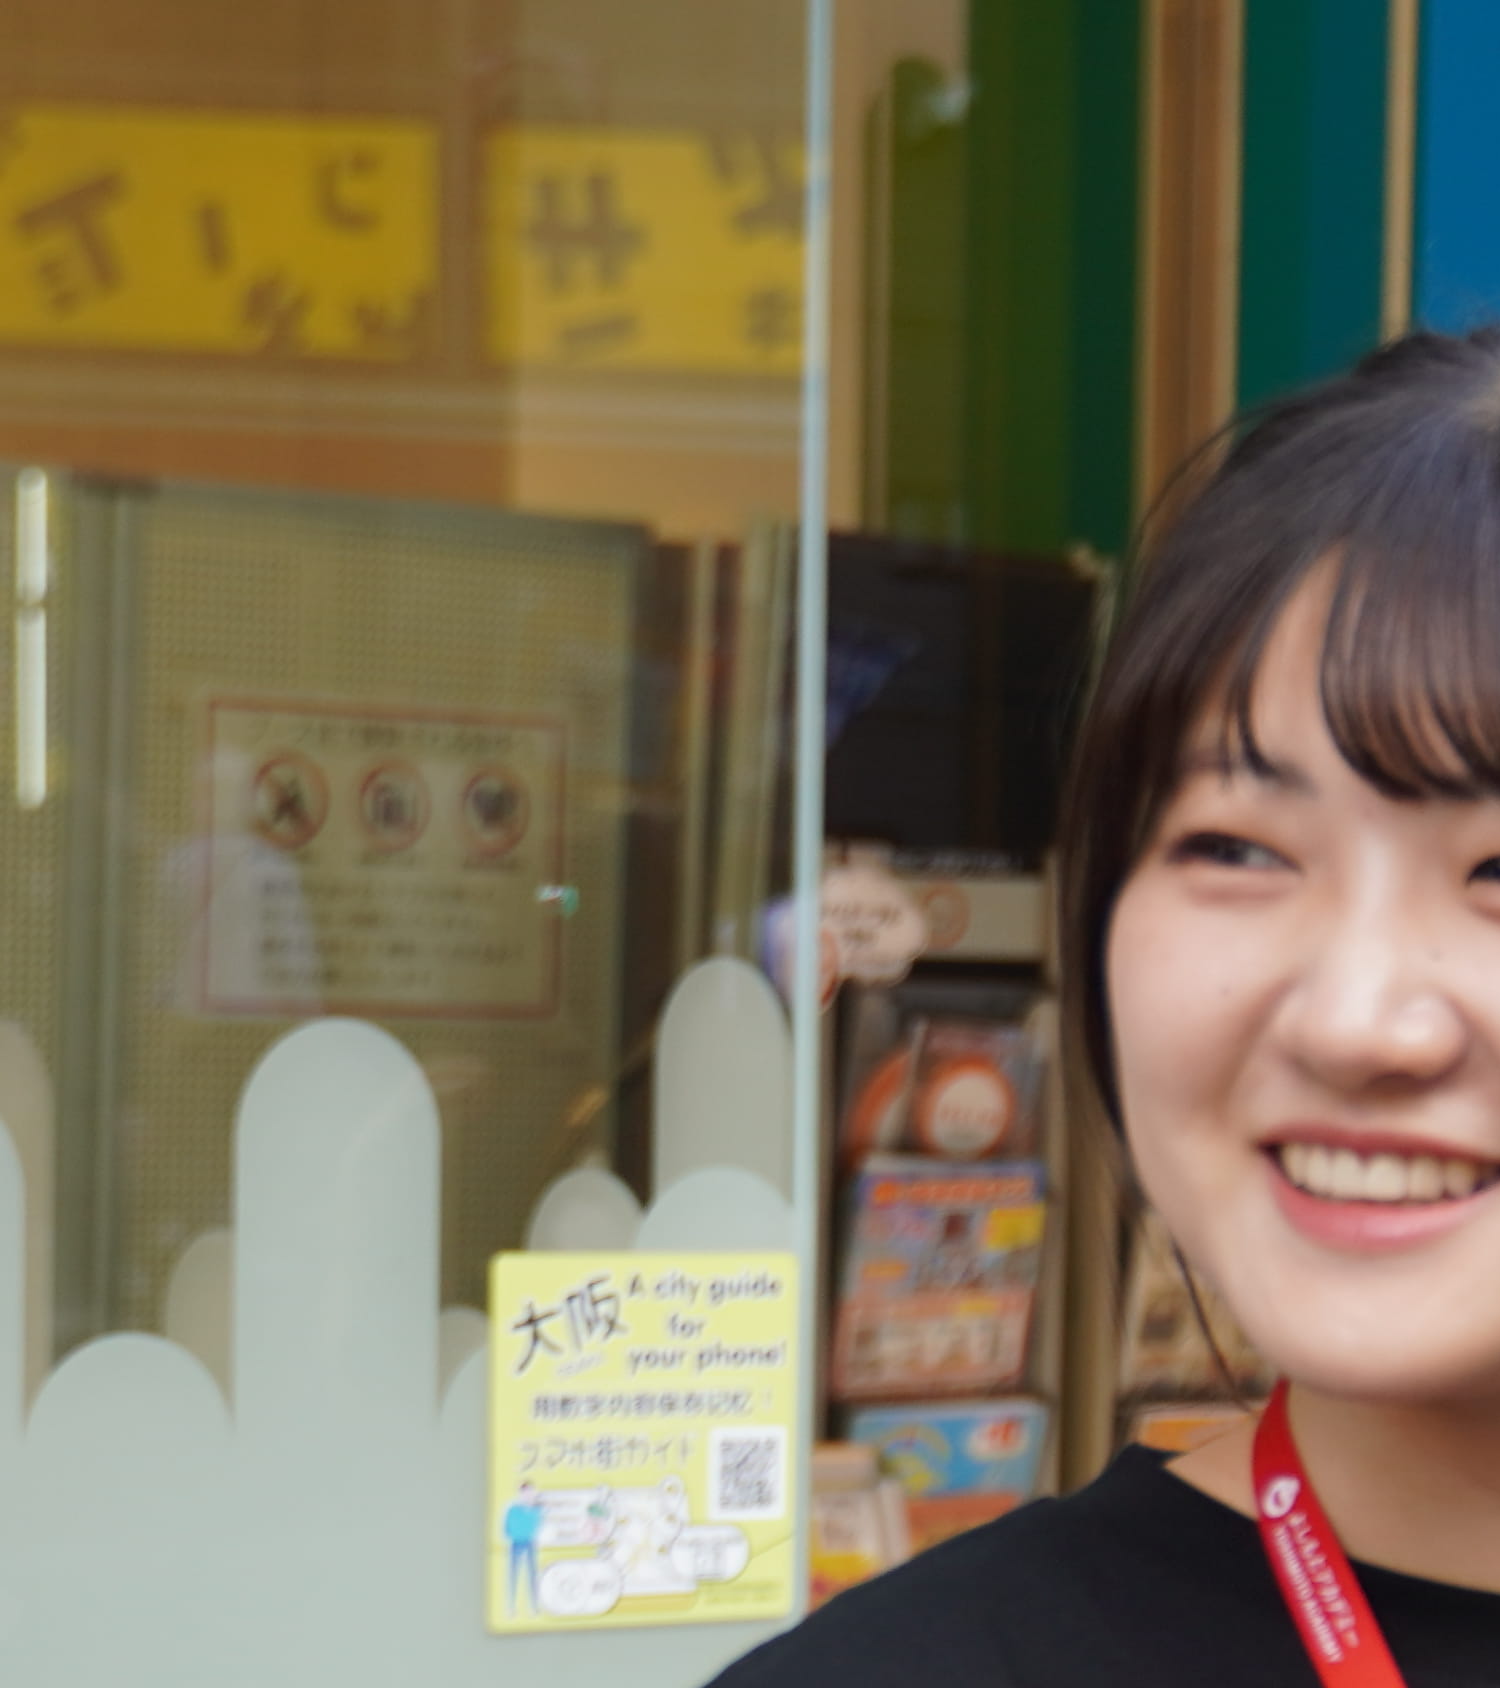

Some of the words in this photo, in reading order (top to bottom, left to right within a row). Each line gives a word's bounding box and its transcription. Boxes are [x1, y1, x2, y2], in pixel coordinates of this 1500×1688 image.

[655, 1276, 700, 1305] city
[709, 1274, 782, 1306] guide
[511, 1276, 629, 1374] 大阪
[669, 1313, 704, 1336] for
[629, 1347, 684, 1374] your
